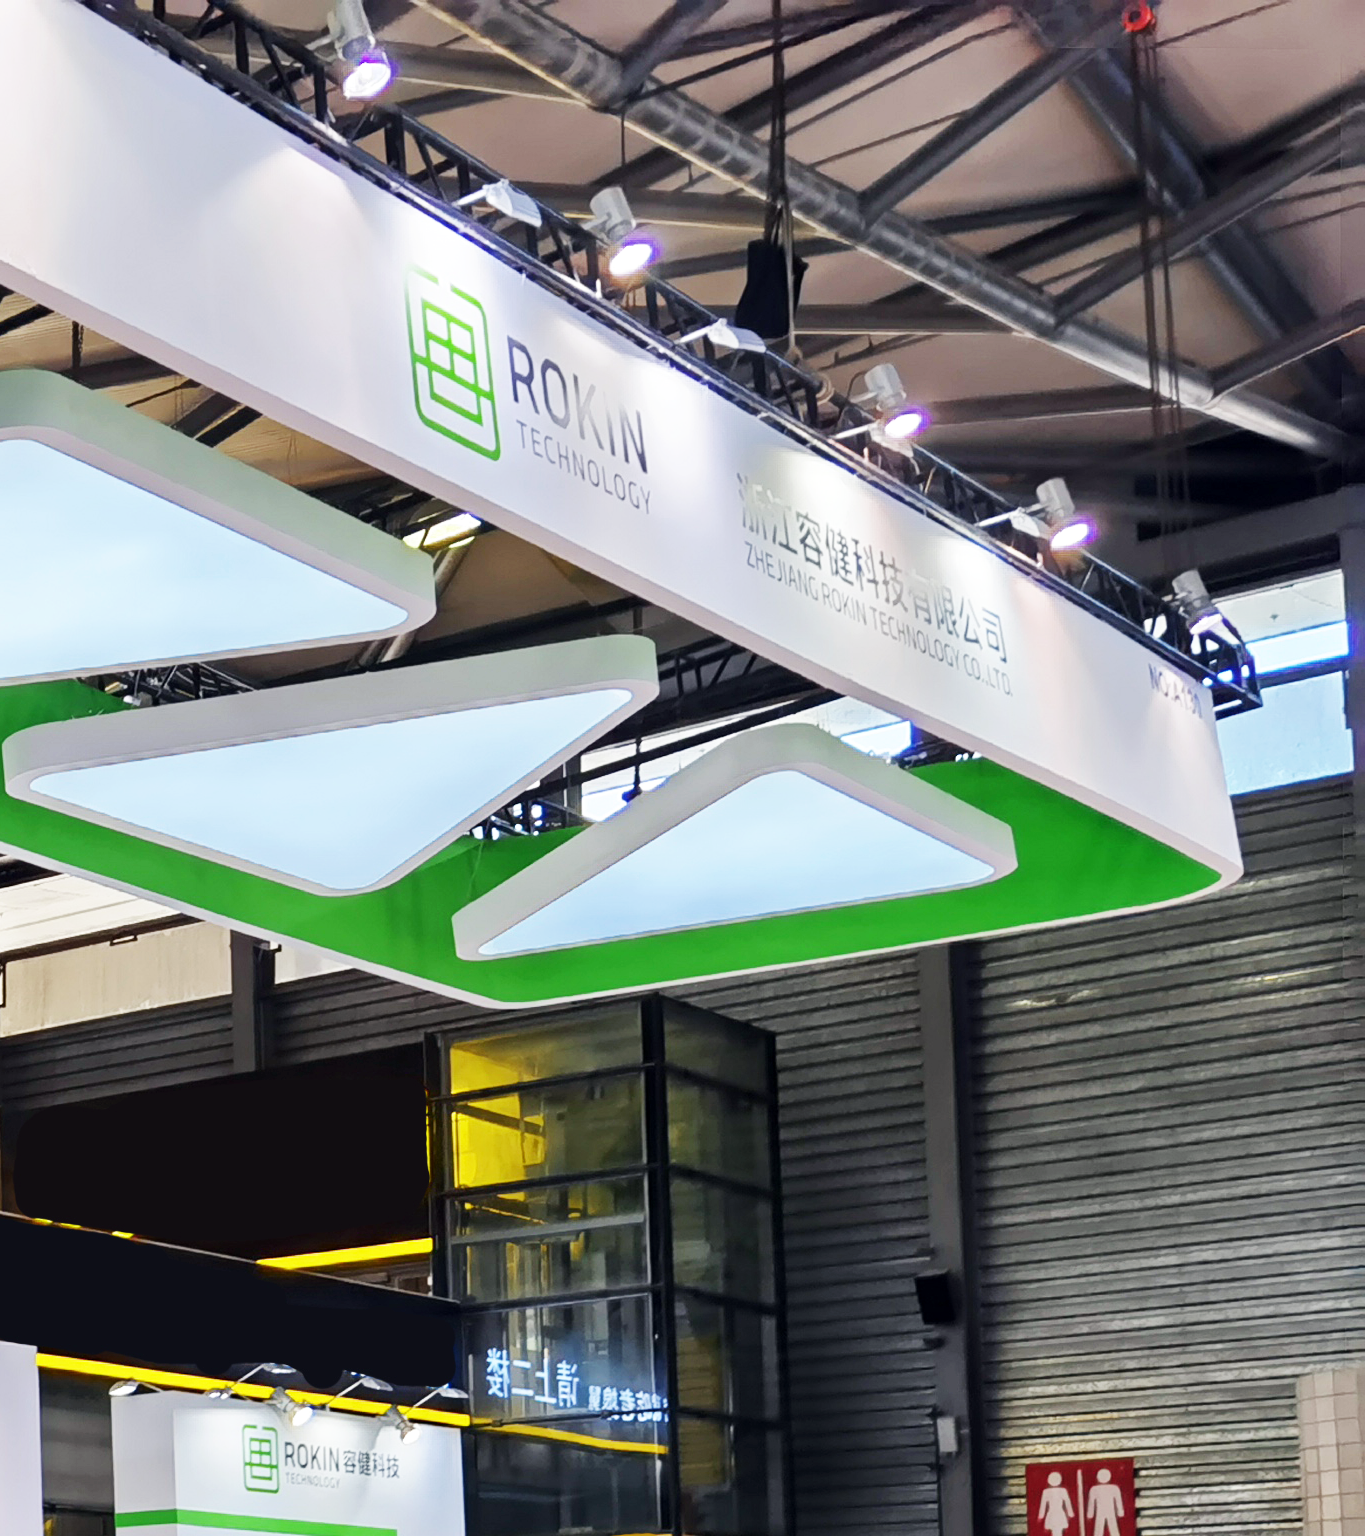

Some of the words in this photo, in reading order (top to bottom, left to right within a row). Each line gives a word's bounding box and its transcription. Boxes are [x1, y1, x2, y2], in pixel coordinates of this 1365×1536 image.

[507, 335, 648, 474] ROKIN
[515, 419, 651, 515] TECHNOLOGY
[744, 540, 819, 602] ZHEJIANG
[822, 583, 868, 626] ROKIN
[870, 606, 961, 668] TECHNOLOGY
[284, 1441, 340, 1473] ROKIN
[342, 1449, 400, 1479] 容健科技
[285, 1471, 341, 1489] TECHNOLOGY
